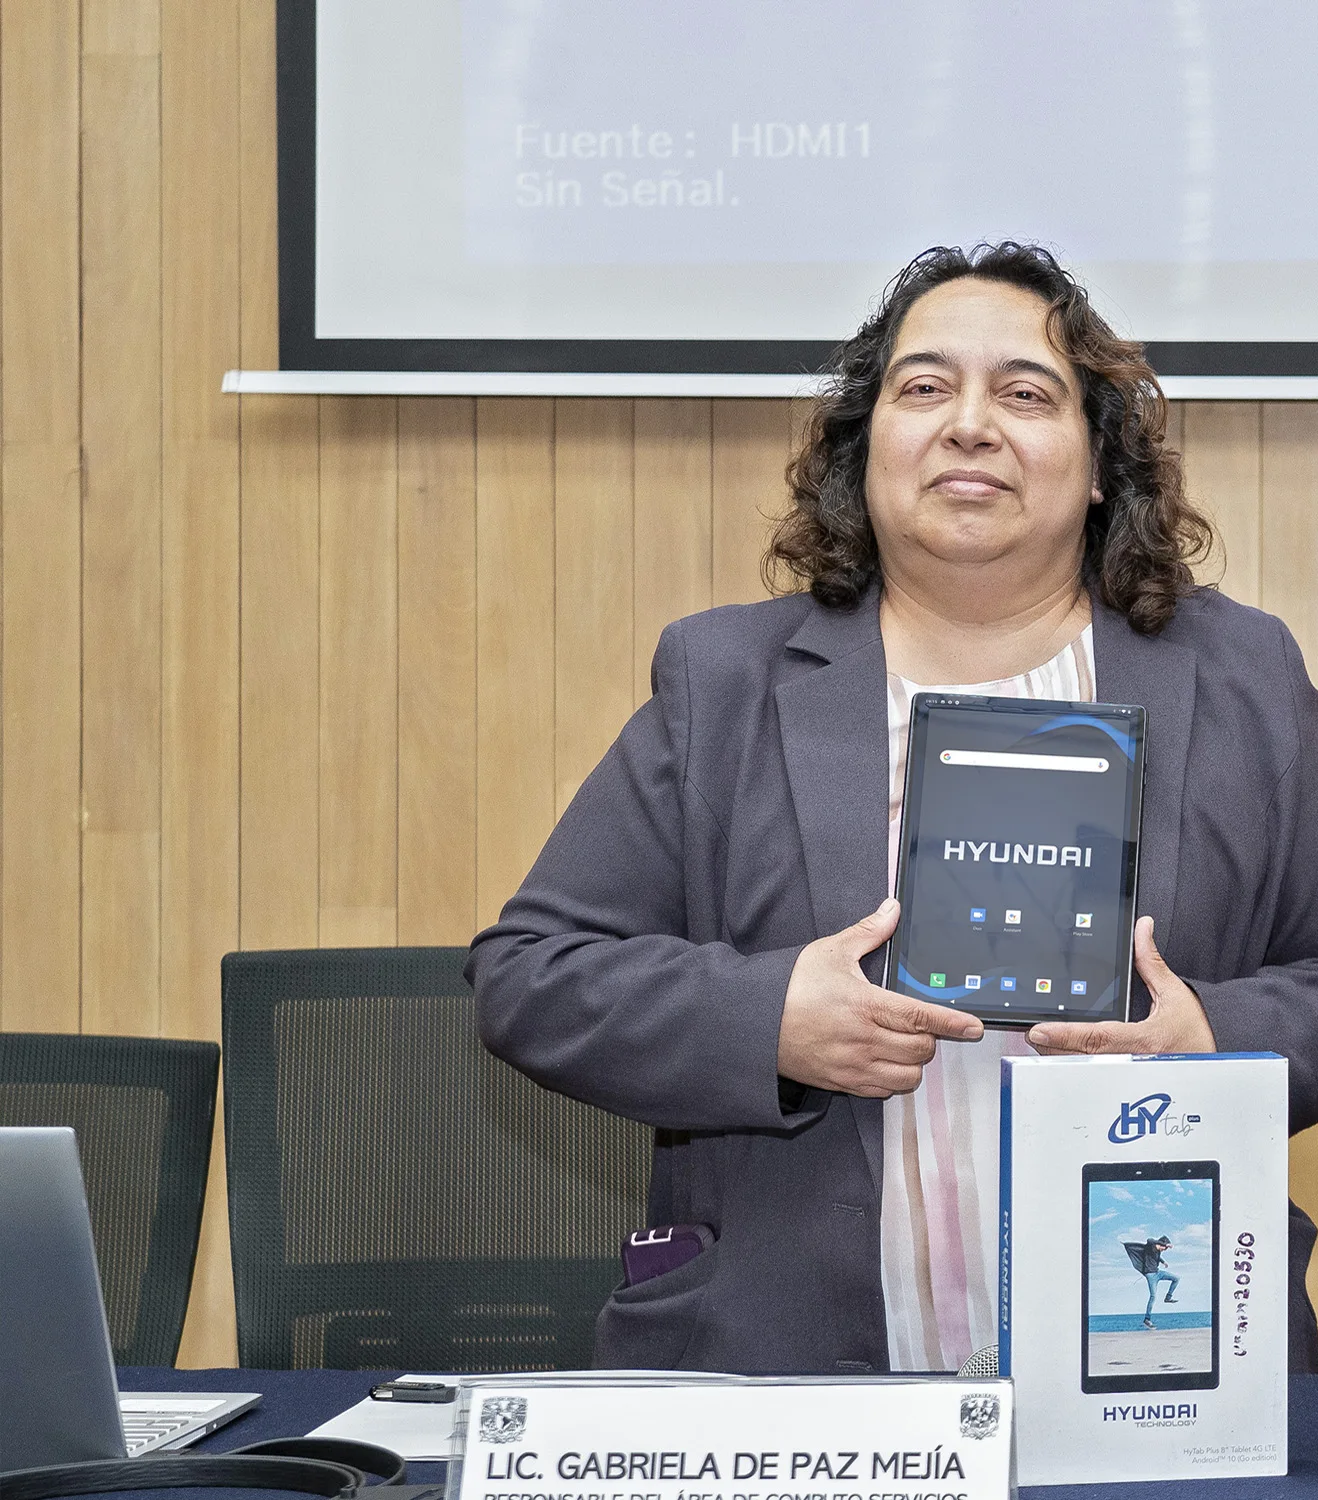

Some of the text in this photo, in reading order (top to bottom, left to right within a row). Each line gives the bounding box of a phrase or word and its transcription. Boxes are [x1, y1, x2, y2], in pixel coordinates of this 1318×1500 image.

[514, 122, 871, 159] Fuente: HDMI1
[515, 169, 740, 207] Sin Señal.
[943, 840, 1092, 868] HYUNDAI
[1103, 1403, 1197, 1421] HYUNDAI
[1135, 1419, 1197, 1428] TECHNOLOGY
[1183, 1447, 1204, 1455] HyTab
[1231, 1445, 1251, 1453] Tablet
[1237, 1454, 1250, 1463] (Go
[1251, 1453, 1277, 1462] edition)
[486, 1444, 966, 1480] LIC. GABRIELA DE PAZ MEJÍA
